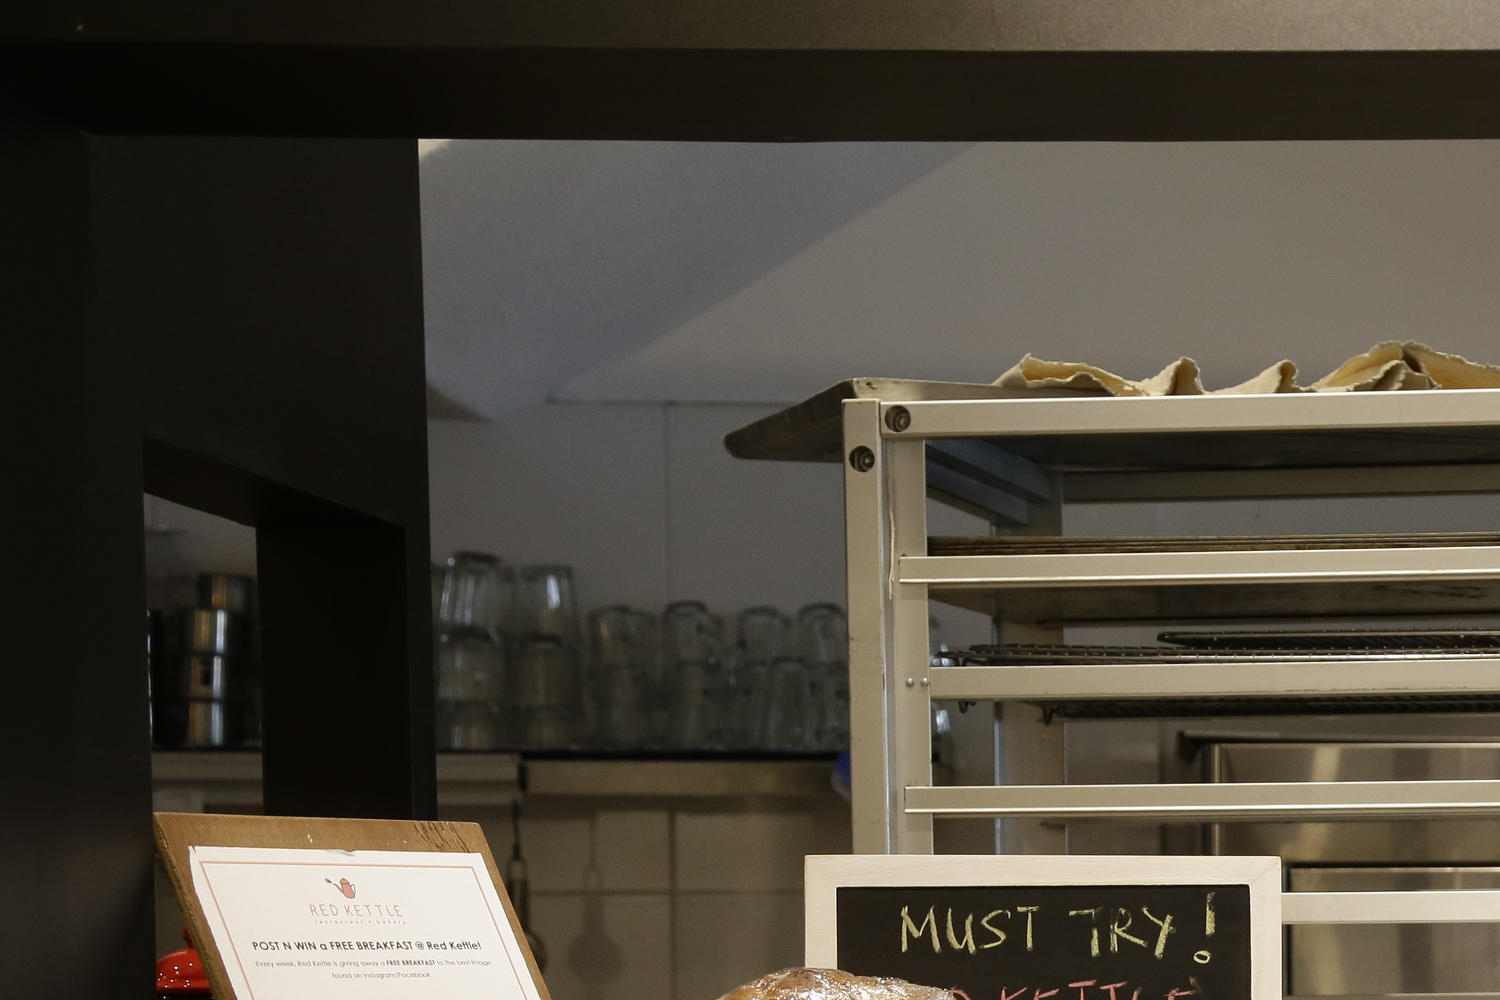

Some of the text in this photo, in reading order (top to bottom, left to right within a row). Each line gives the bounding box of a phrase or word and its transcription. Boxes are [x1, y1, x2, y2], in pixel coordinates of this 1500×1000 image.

[308, 904, 403, 917] RED KETTLE
[899, 904, 1040, 955] MUST
[251, 941, 281, 951] POST
[282, 941, 293, 951] N
[294, 941, 318, 951] WIN
[329, 941, 355, 951] FREE
[356, 941, 414, 951] BREAKFAST
[415, 941, 425, 951] @
[426, 941, 448, 951] Red
[255, 960, 274, 968] Every
[339, 960, 360, 968] giving
[386, 959, 401, 967] FREE
[401, 959, 436, 967] BREAKFAST
